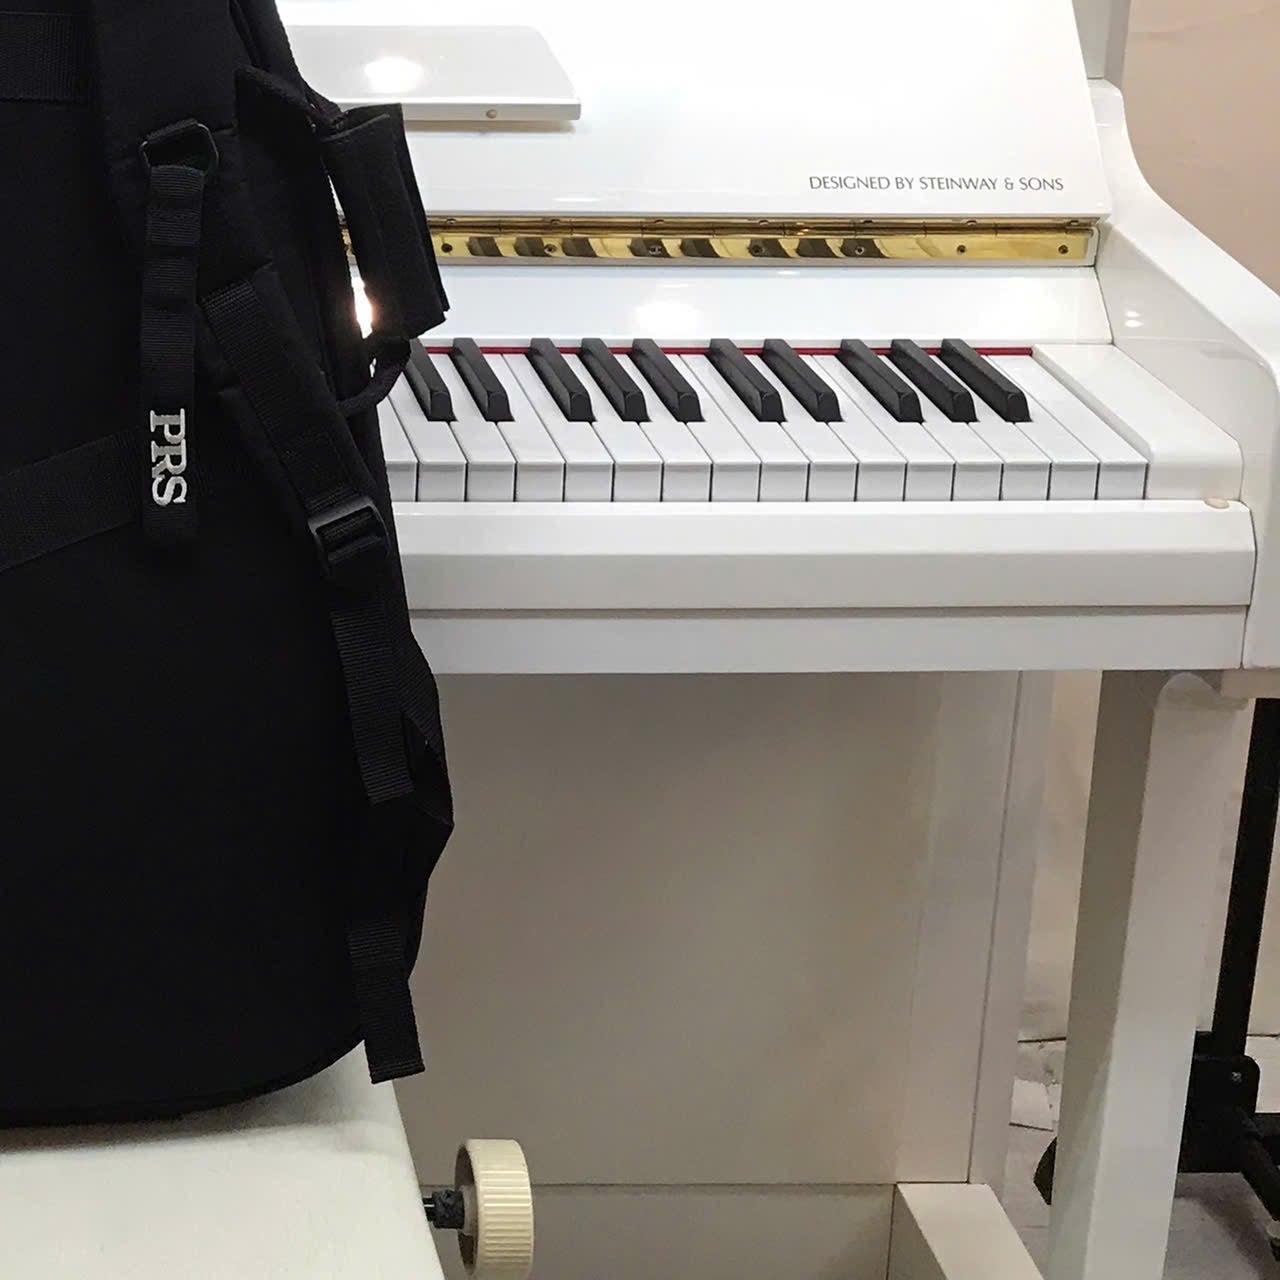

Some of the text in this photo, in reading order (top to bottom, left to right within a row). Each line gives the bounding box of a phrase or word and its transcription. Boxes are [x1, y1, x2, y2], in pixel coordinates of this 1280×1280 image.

[809, 176, 1064, 191] DESIGNED BY STEINWAY & SONS
[149, 408, 187, 506] PRS
